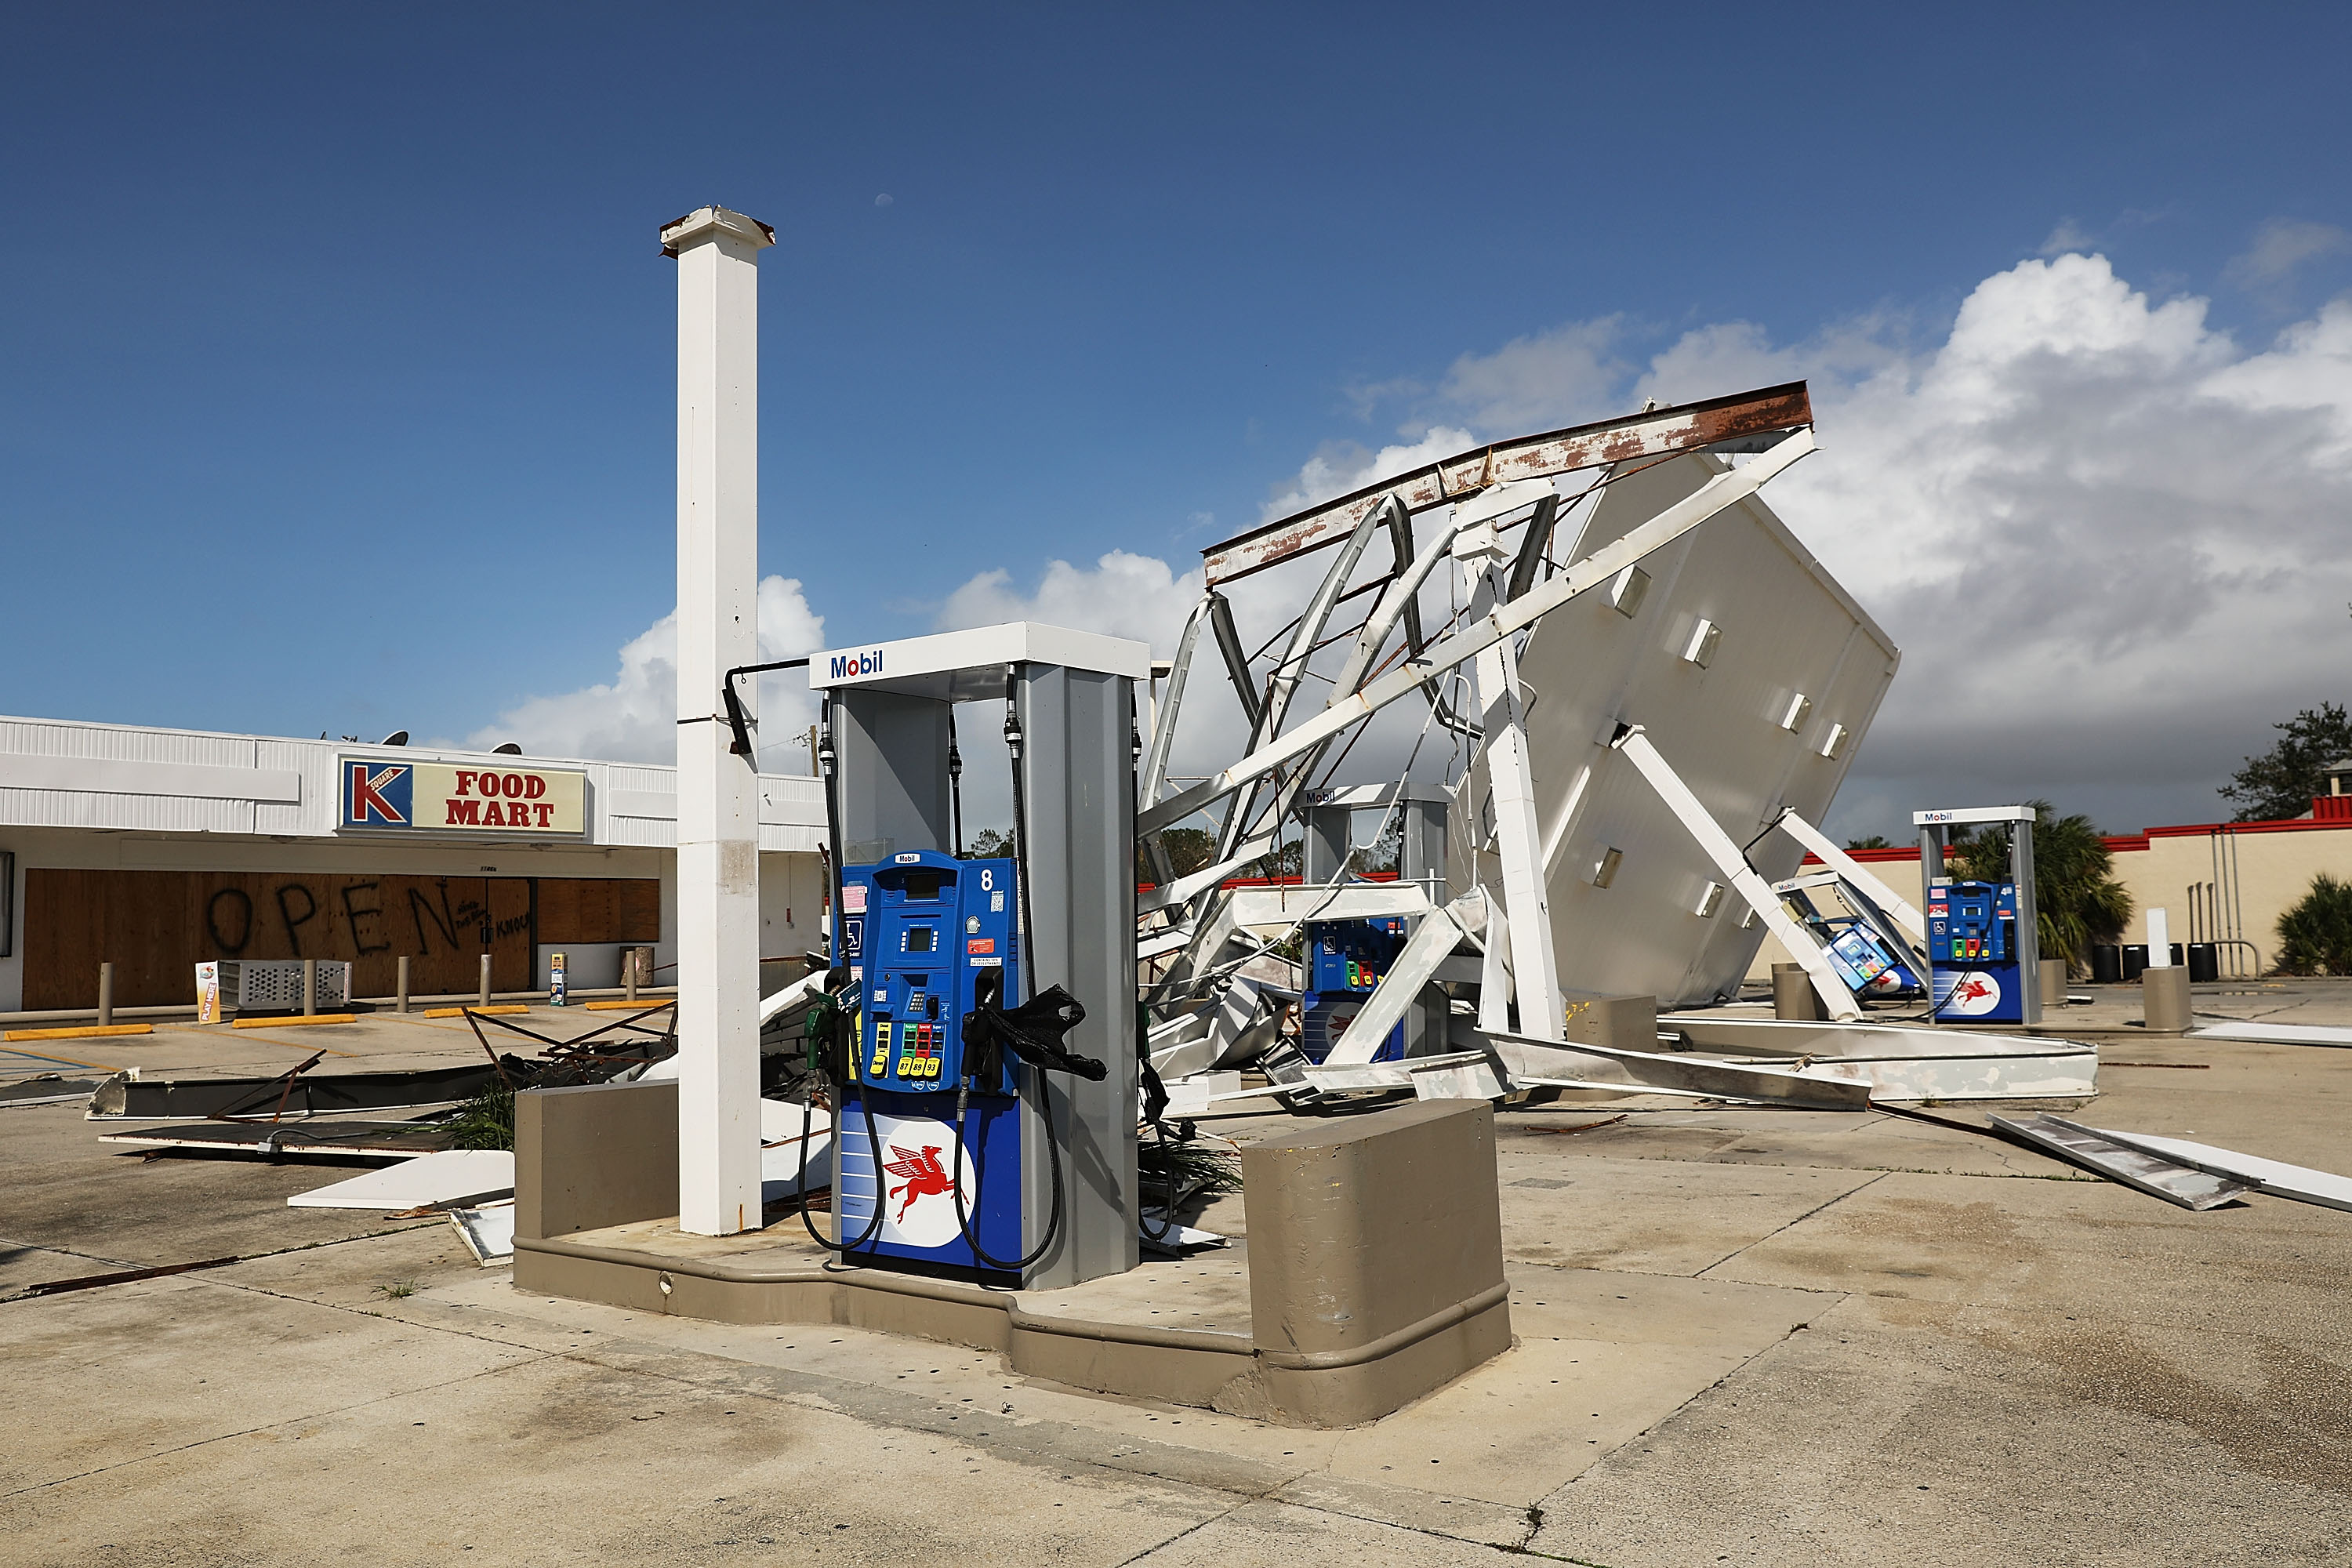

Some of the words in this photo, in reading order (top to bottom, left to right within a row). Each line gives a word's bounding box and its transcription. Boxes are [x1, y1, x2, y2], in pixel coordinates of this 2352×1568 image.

[831, 650, 883, 679] Mobil
[370, 769, 394, 791] SQUARE
[456, 770, 546, 799] FOOD
[352, 764, 408, 823] K
[1306, 790, 1335, 804] Mobil
[445, 798, 554, 828] MART
[1925, 812, 1952, 822] Mobil
[981, 869, 993, 891] 8
[1778, 882, 1795, 891] Mobil
[207, 881, 460, 956] OPEN
[205, 982, 217, 1002] HERE
[201, 1001, 212, 1021] PLAY
